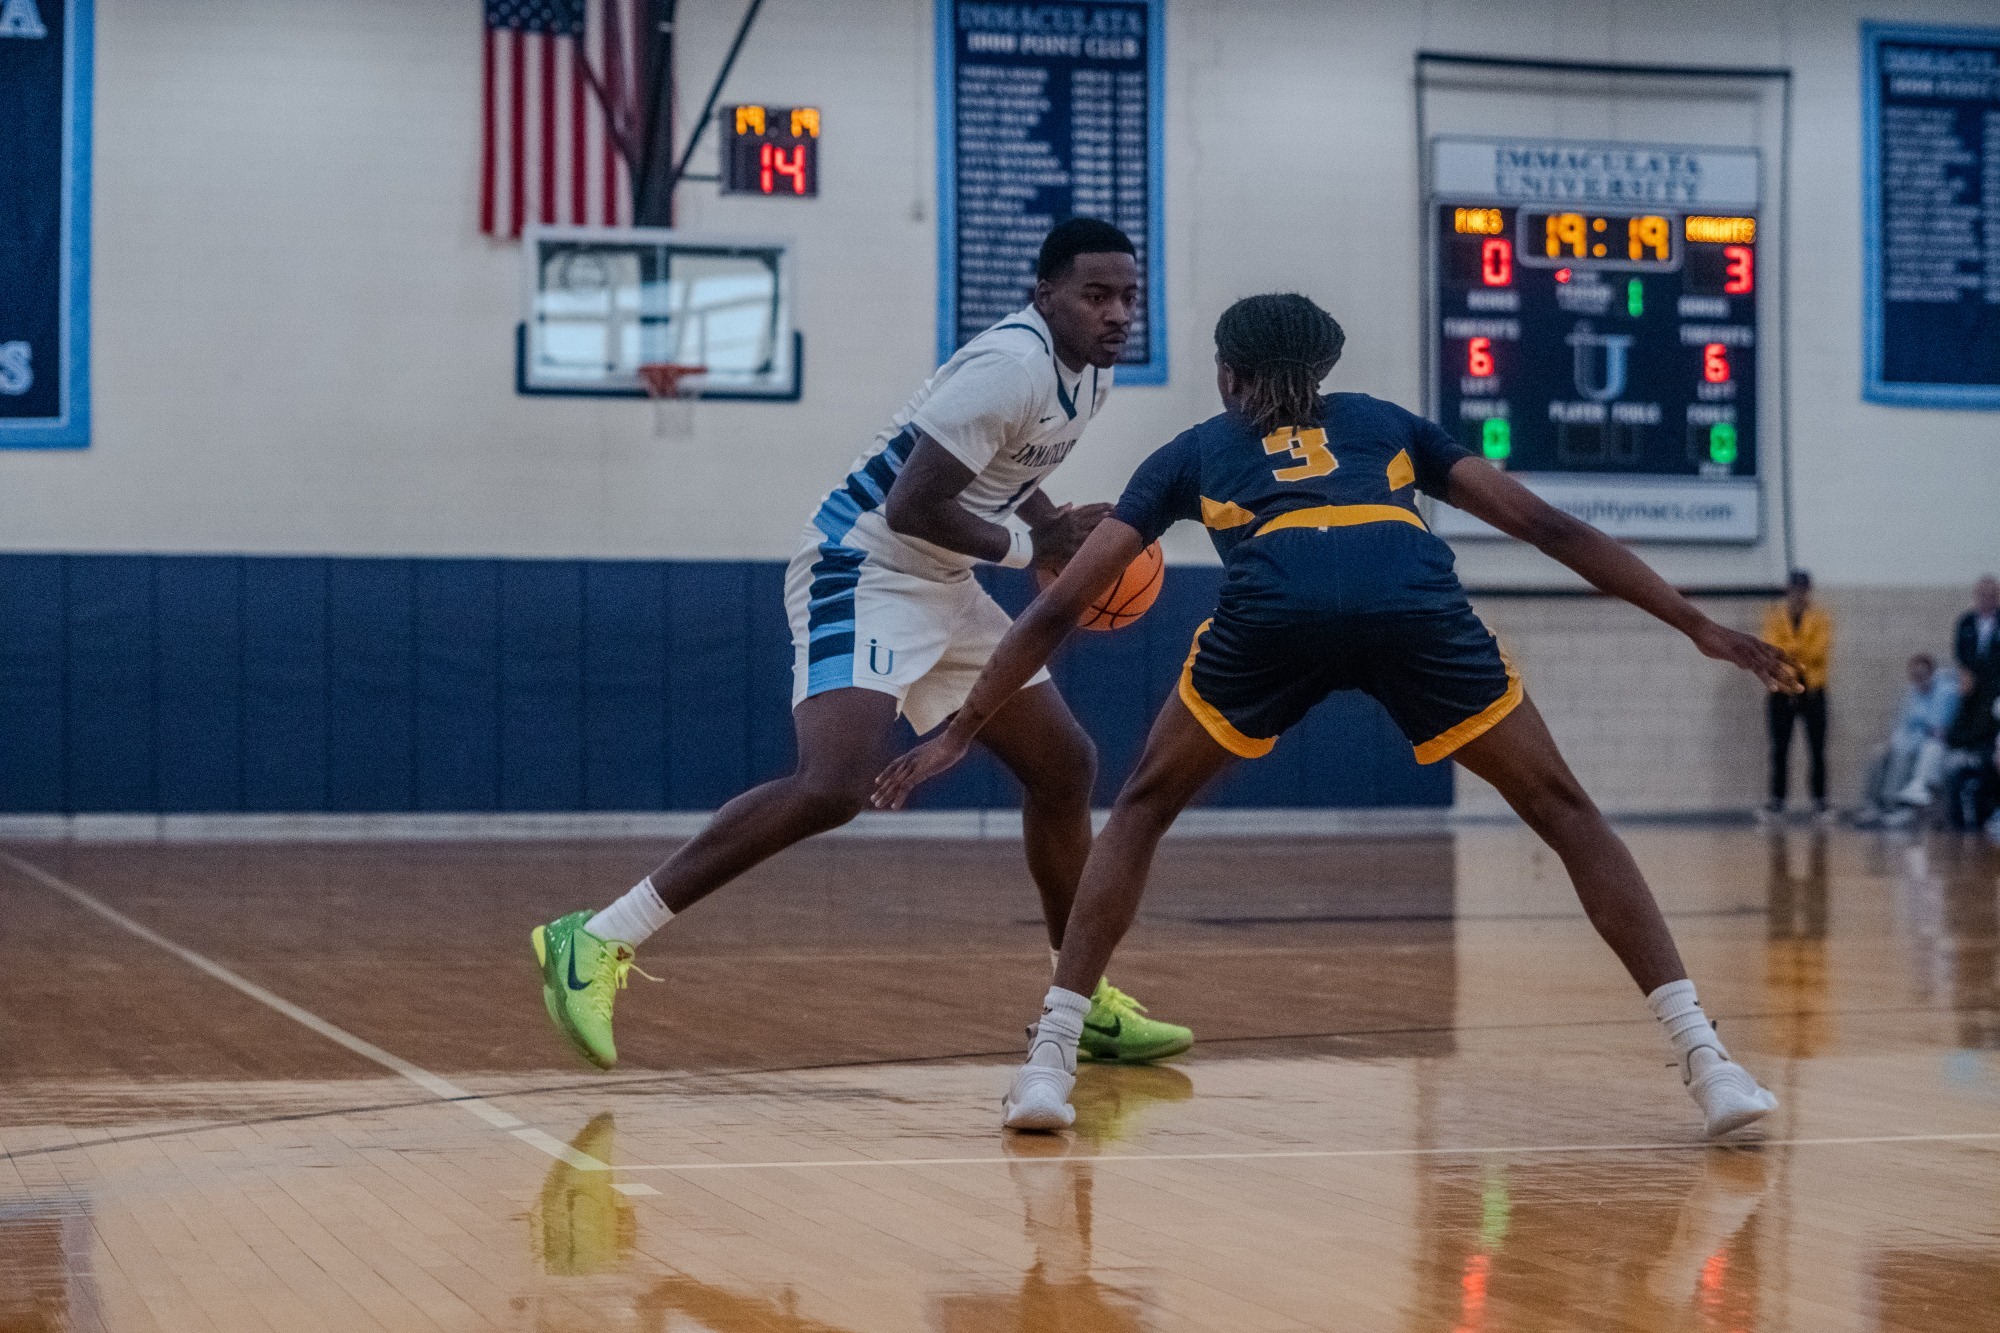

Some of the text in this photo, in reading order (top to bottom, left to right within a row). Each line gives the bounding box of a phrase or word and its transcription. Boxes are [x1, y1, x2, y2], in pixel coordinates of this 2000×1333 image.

[761, 143, 806, 195] 14
[1496, 148, 1700, 176] IMMACULATA
[1496, 171, 1699, 200] UNIVERSITY
[1482, 237, 1512, 287] 0
[1724, 246, 1754, 294] 3
[1468, 336, 1495, 377] 6
[1703, 343, 1731, 384] 6
[1262, 425, 1340, 482] 3
